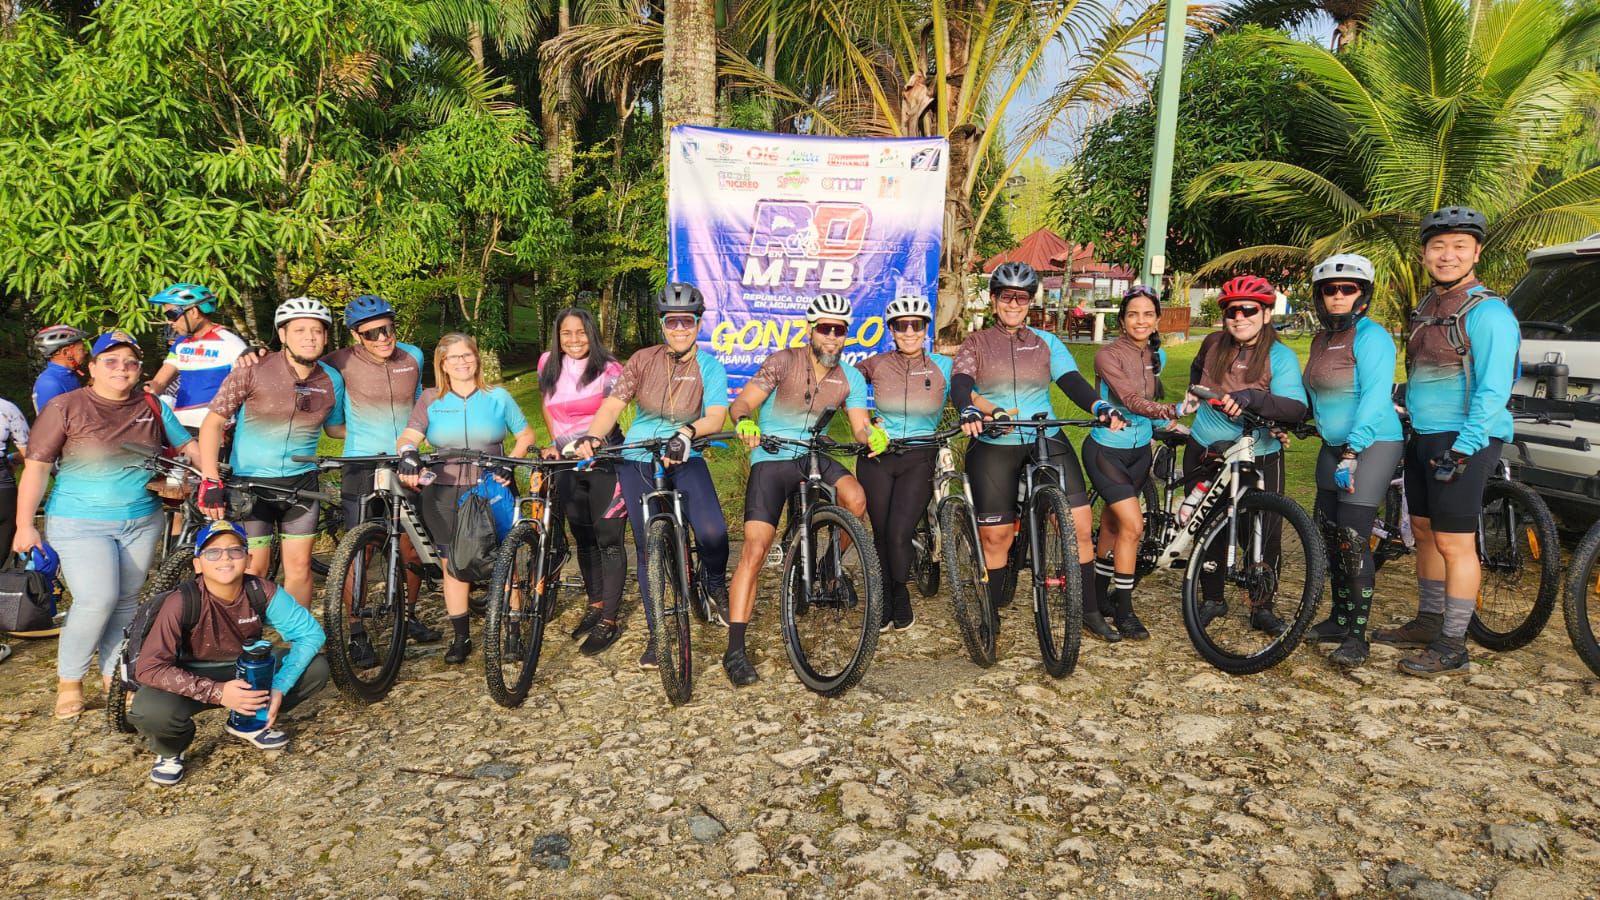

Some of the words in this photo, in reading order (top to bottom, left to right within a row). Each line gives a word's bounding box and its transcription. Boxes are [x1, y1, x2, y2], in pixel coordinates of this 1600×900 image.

[742, 257, 855, 290] MTB
[754, 301, 768, 309] EN
[711, 315, 885, 355] GONZO
[1187, 478, 1226, 536] GIANT
